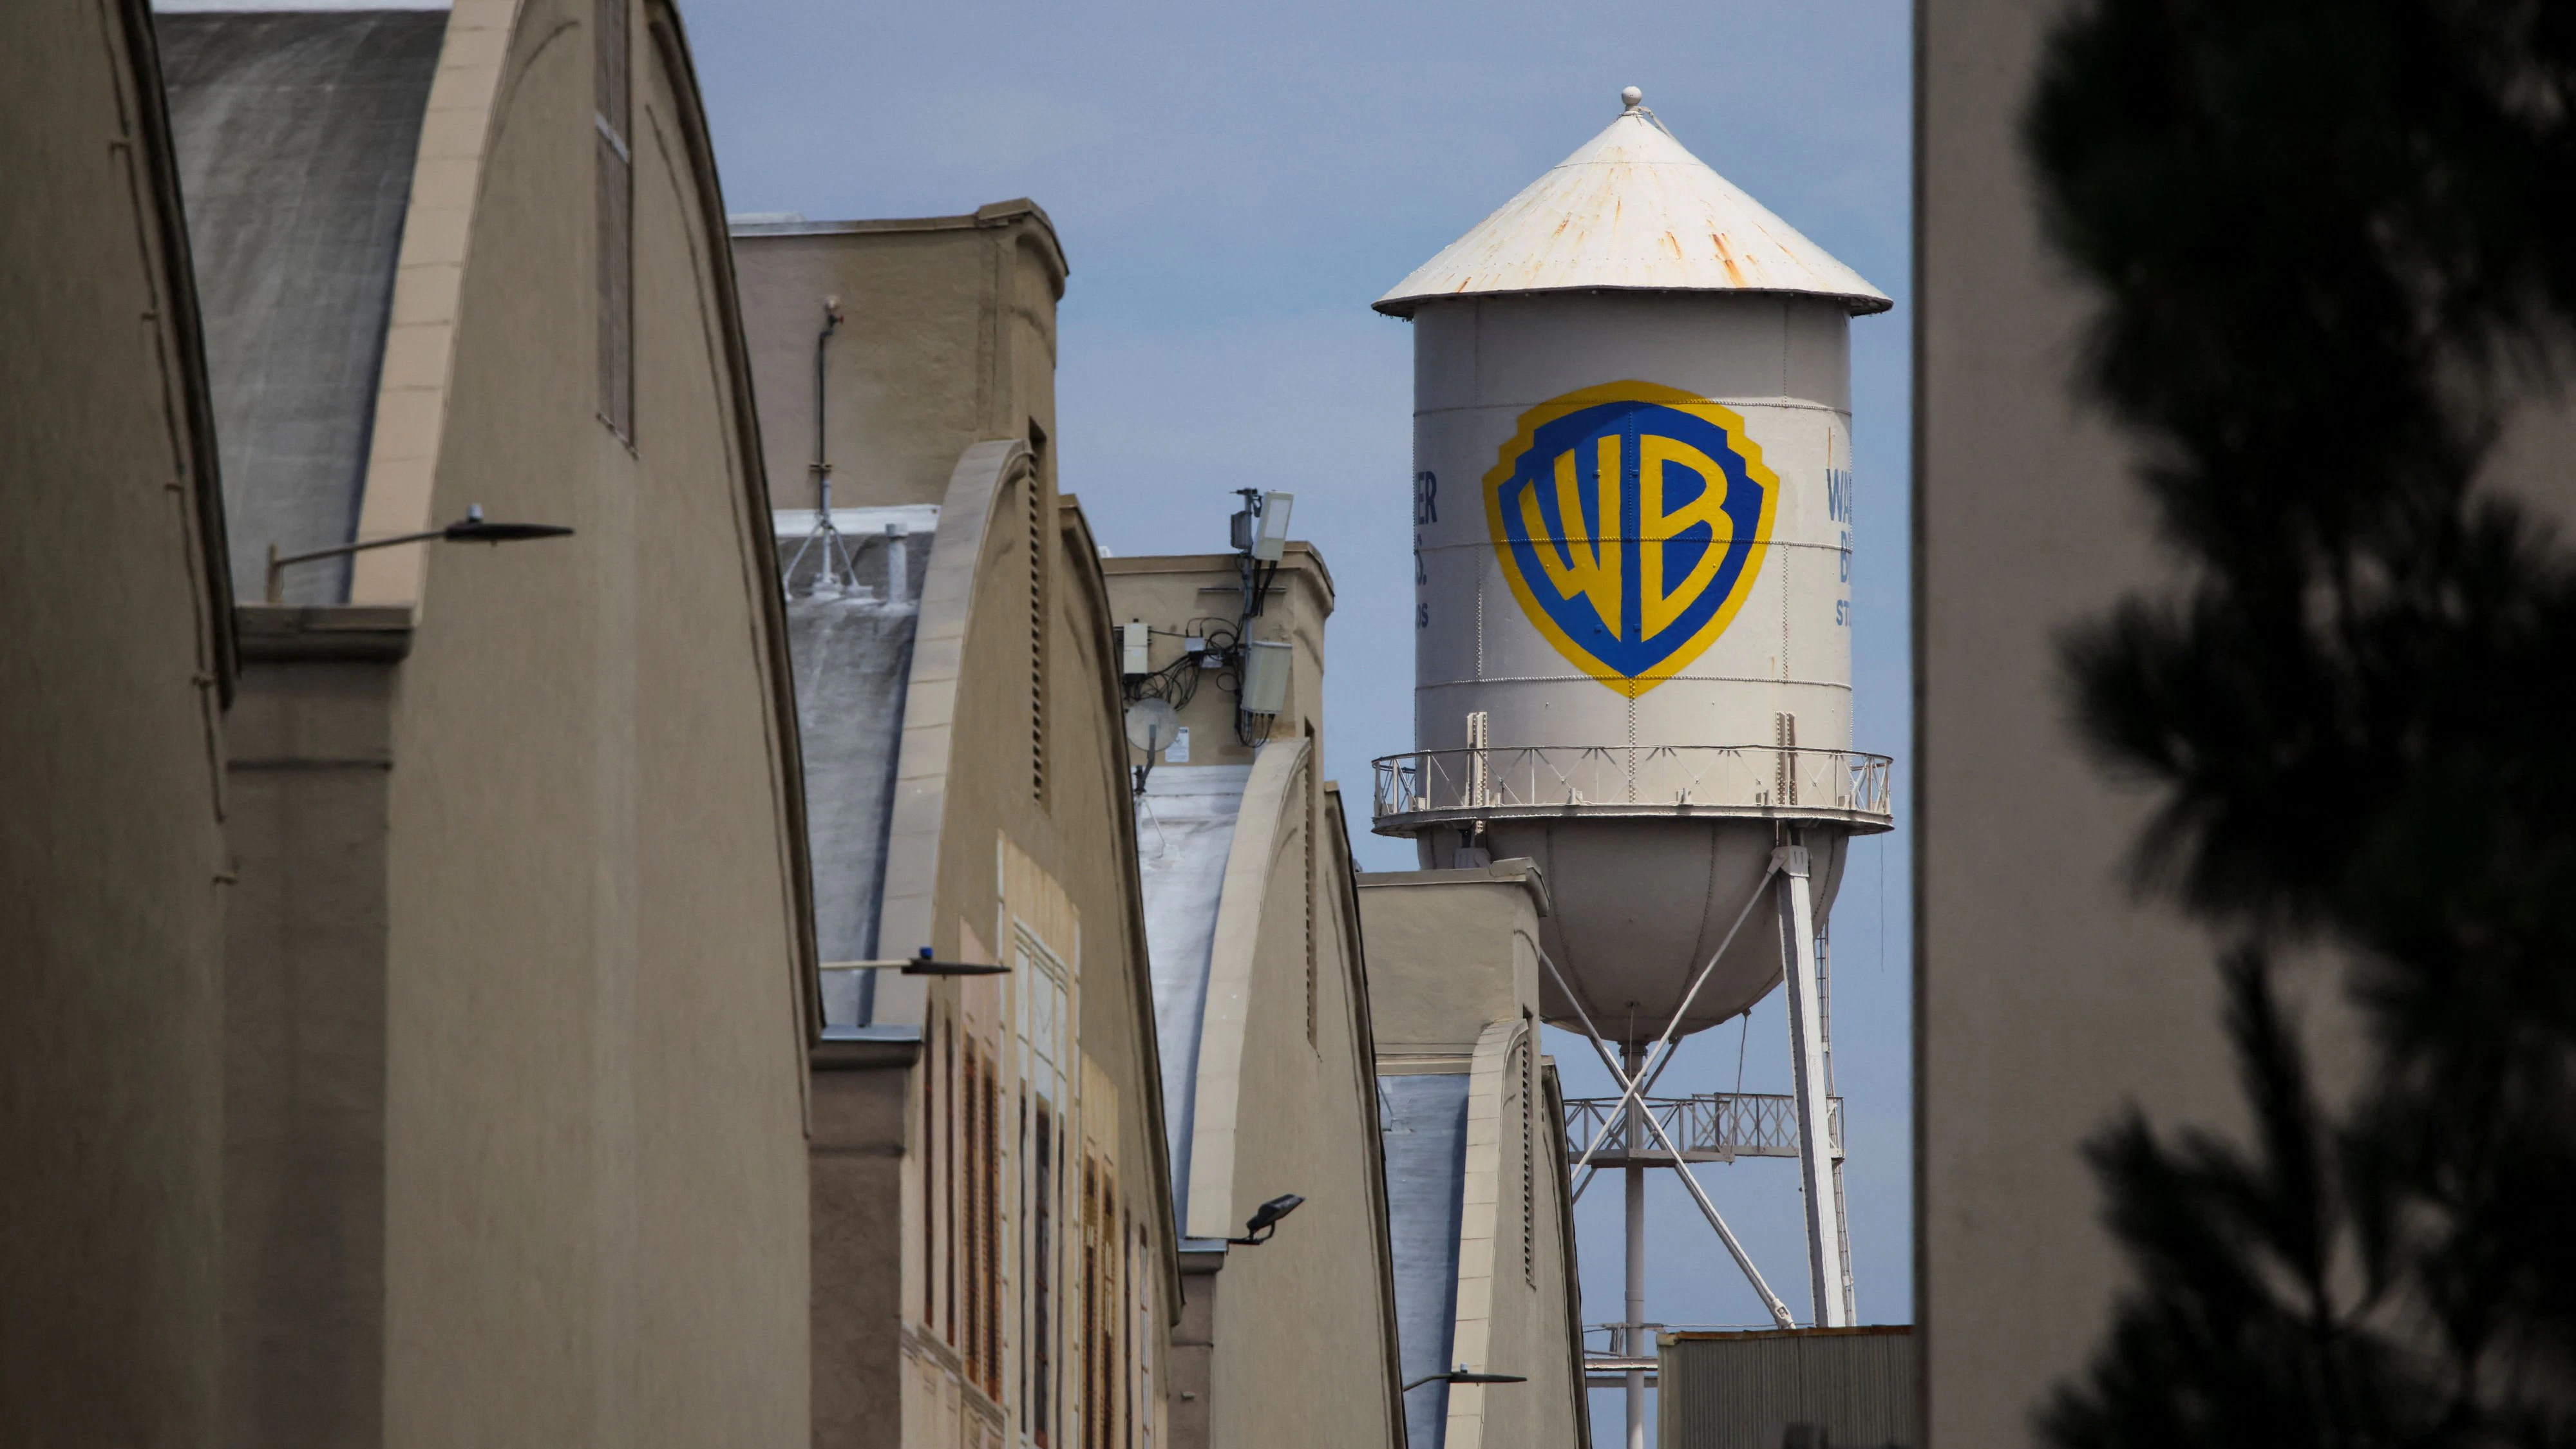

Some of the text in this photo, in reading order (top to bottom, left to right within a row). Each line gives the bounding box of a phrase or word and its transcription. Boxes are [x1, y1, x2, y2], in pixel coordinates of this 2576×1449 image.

[1826, 469, 1852, 524] WA
[1518, 434, 1734, 643] WB
[1836, 600, 1852, 627] ST
